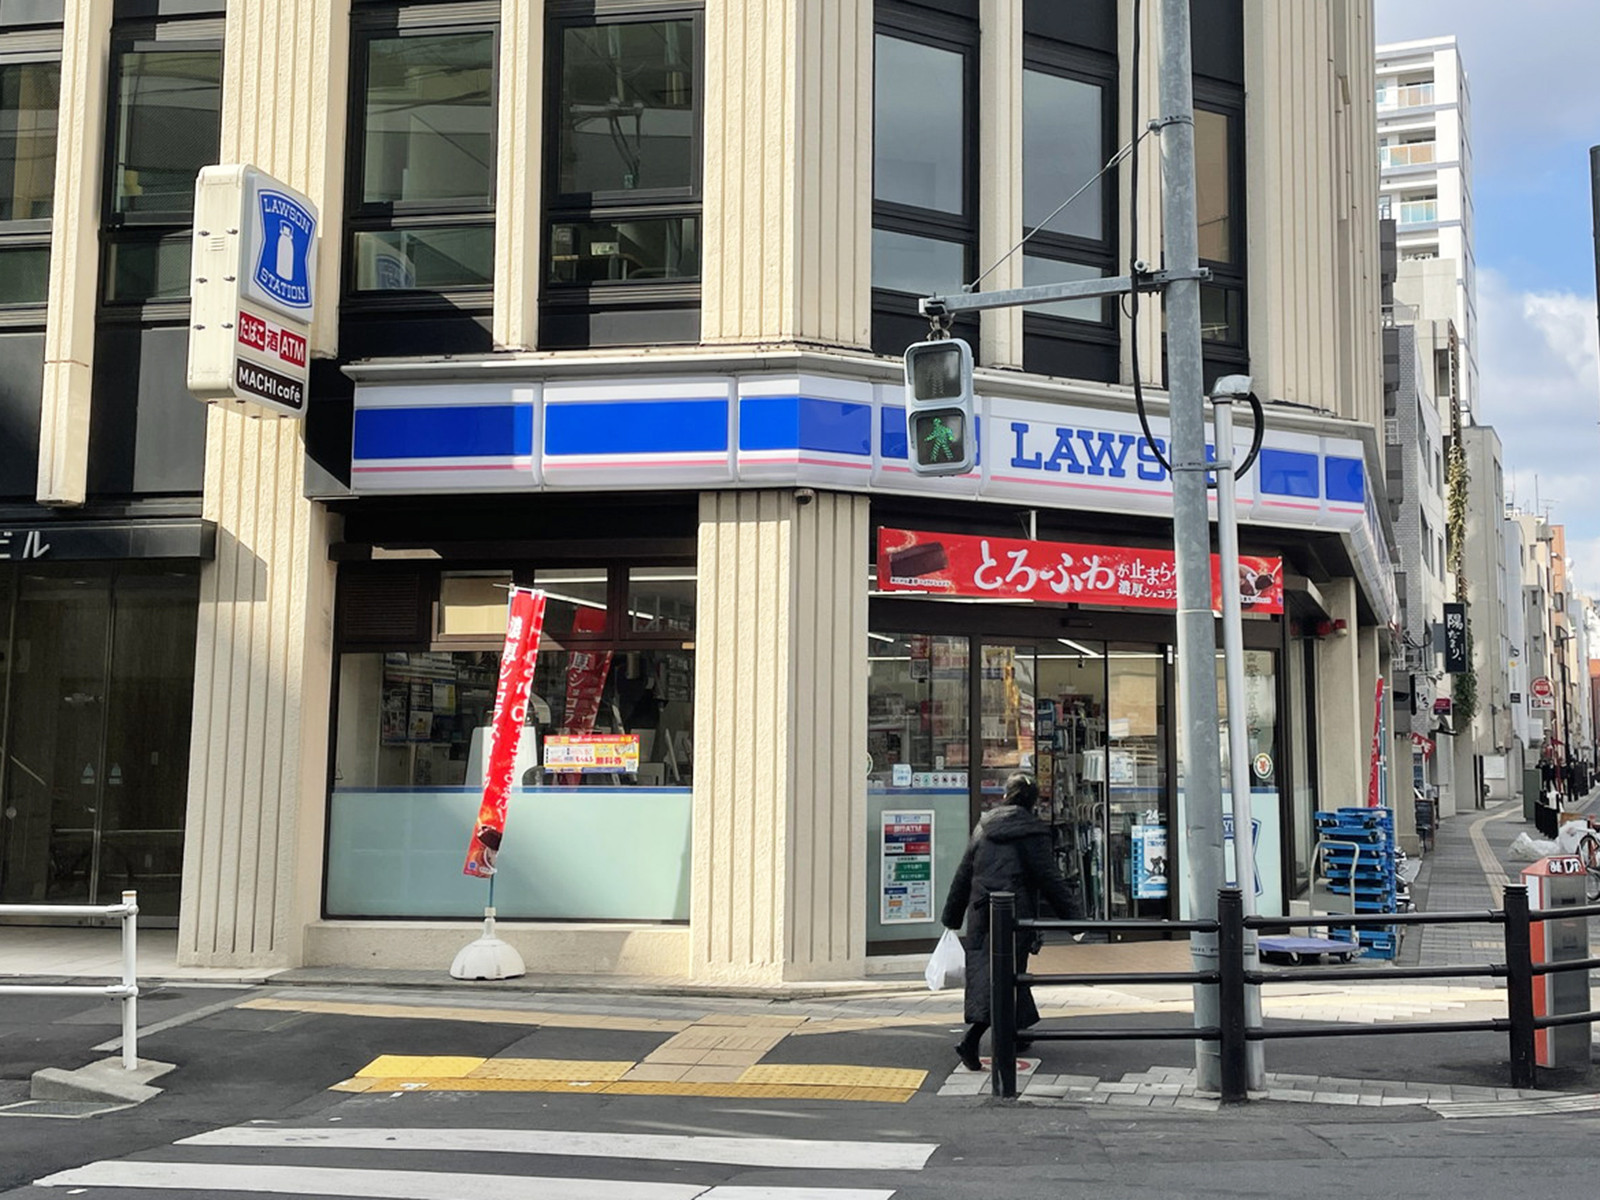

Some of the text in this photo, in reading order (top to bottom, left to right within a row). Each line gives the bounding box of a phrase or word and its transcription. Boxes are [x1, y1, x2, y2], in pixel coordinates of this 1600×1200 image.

[263, 198, 311, 235] LAWSON
[260, 267, 307, 301] STATION
[240, 317, 304, 362] たばこ 酒 ATM
[239, 366, 301, 403] MACHI café
[1010, 421, 1236, 485] LAWS
